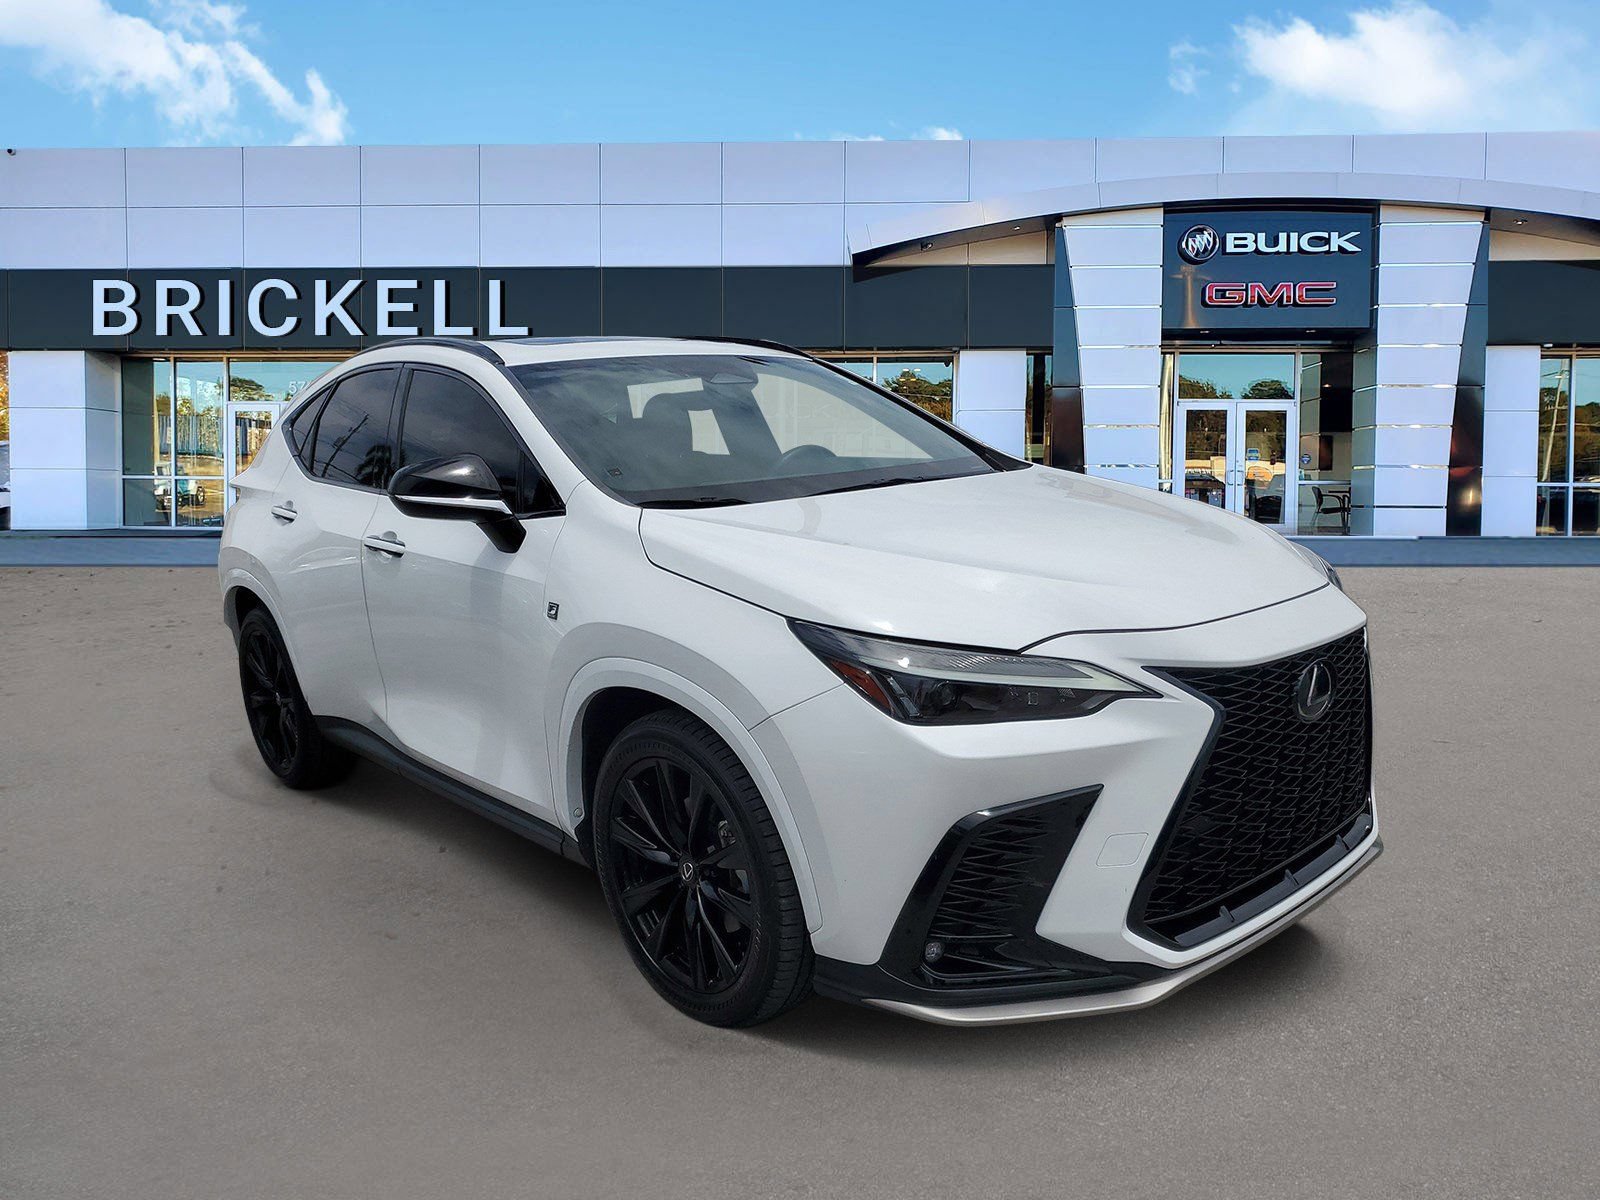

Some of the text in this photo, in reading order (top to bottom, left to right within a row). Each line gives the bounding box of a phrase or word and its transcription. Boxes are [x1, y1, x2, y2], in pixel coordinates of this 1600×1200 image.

[1225, 231, 1362, 253] BUICK
[1205, 281, 1337, 305] GMC
[92, 279, 530, 337] BRICKELL
